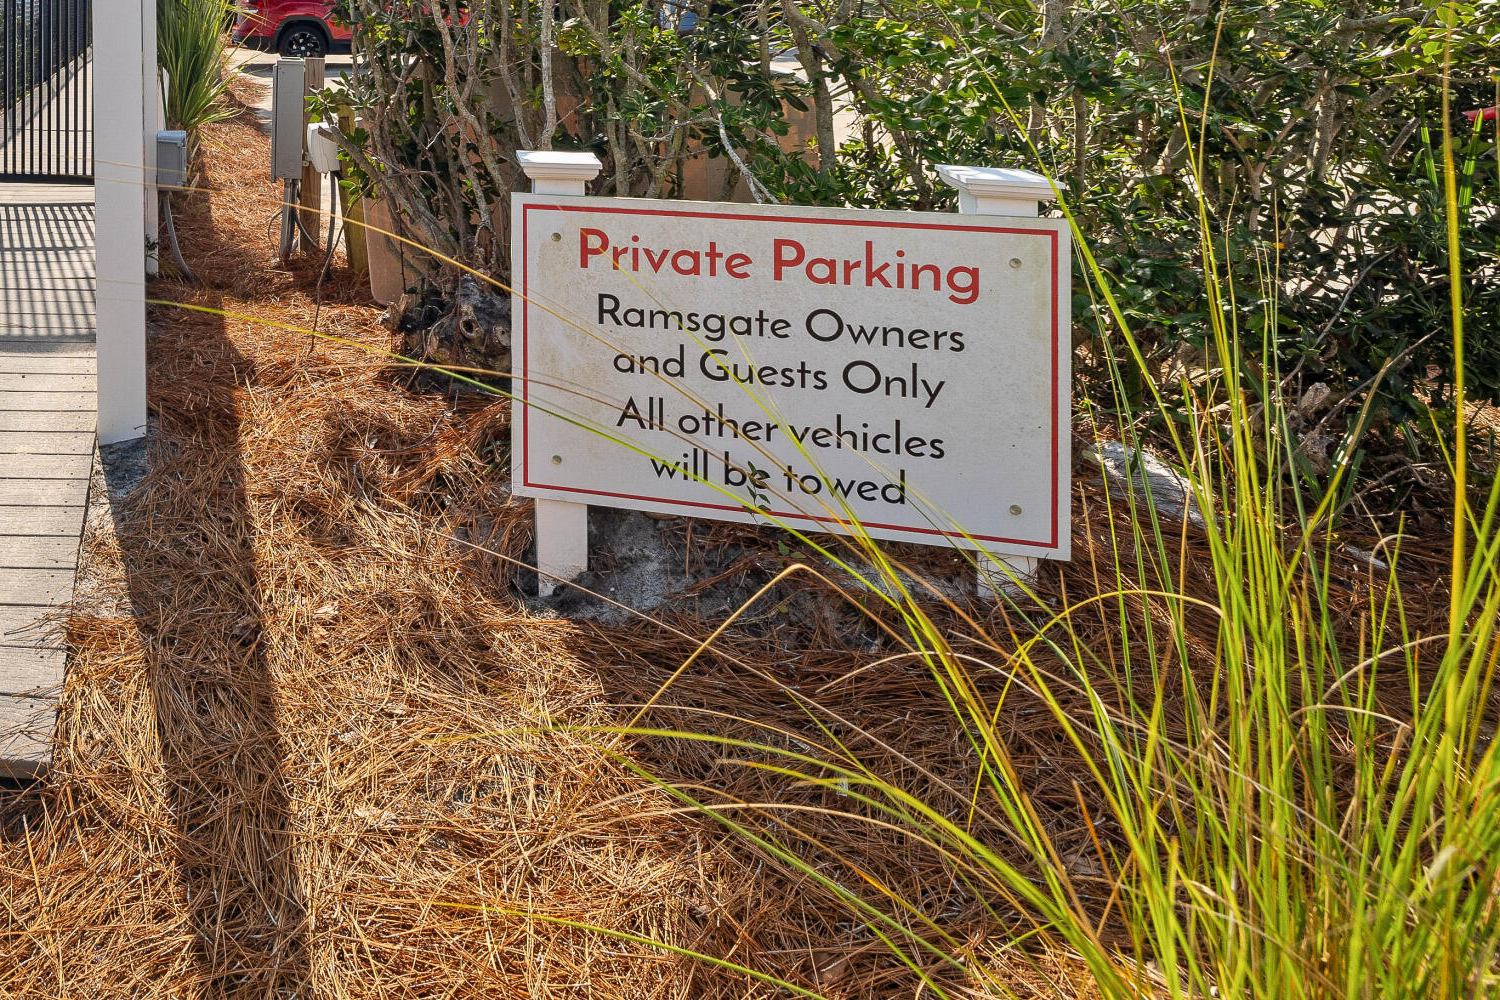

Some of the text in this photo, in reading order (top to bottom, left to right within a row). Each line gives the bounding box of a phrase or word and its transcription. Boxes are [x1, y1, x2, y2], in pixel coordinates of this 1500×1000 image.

[579, 228, 980, 304] Private Parking
[598, 293, 964, 353] Ramsgate Owners
[613, 345, 945, 408] and Guests Only
[617, 396, 945, 459] All other vehicles
[650, 449, 708, 482] will
[784, 464, 906, 505] towed
